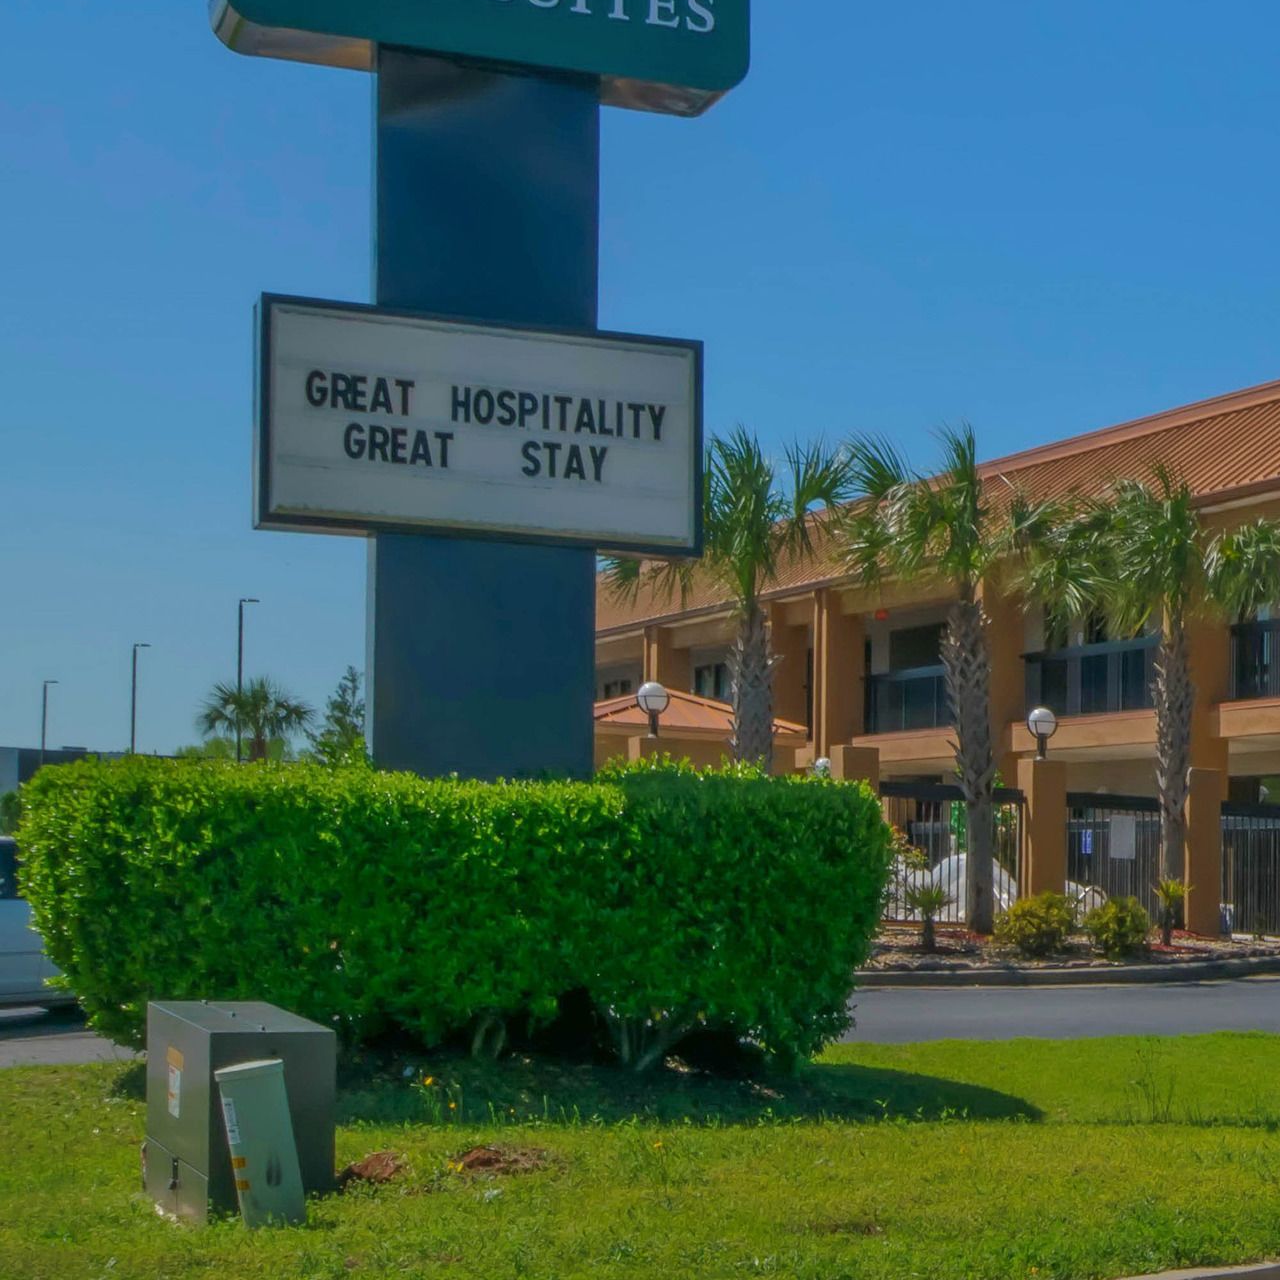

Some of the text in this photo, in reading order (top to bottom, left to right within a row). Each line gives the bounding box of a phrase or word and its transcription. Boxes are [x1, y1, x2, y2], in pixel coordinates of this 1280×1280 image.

[305, 369, 667, 441] GREAT HOSPITALITY
[343, 423, 609, 483] GREAT STAY
